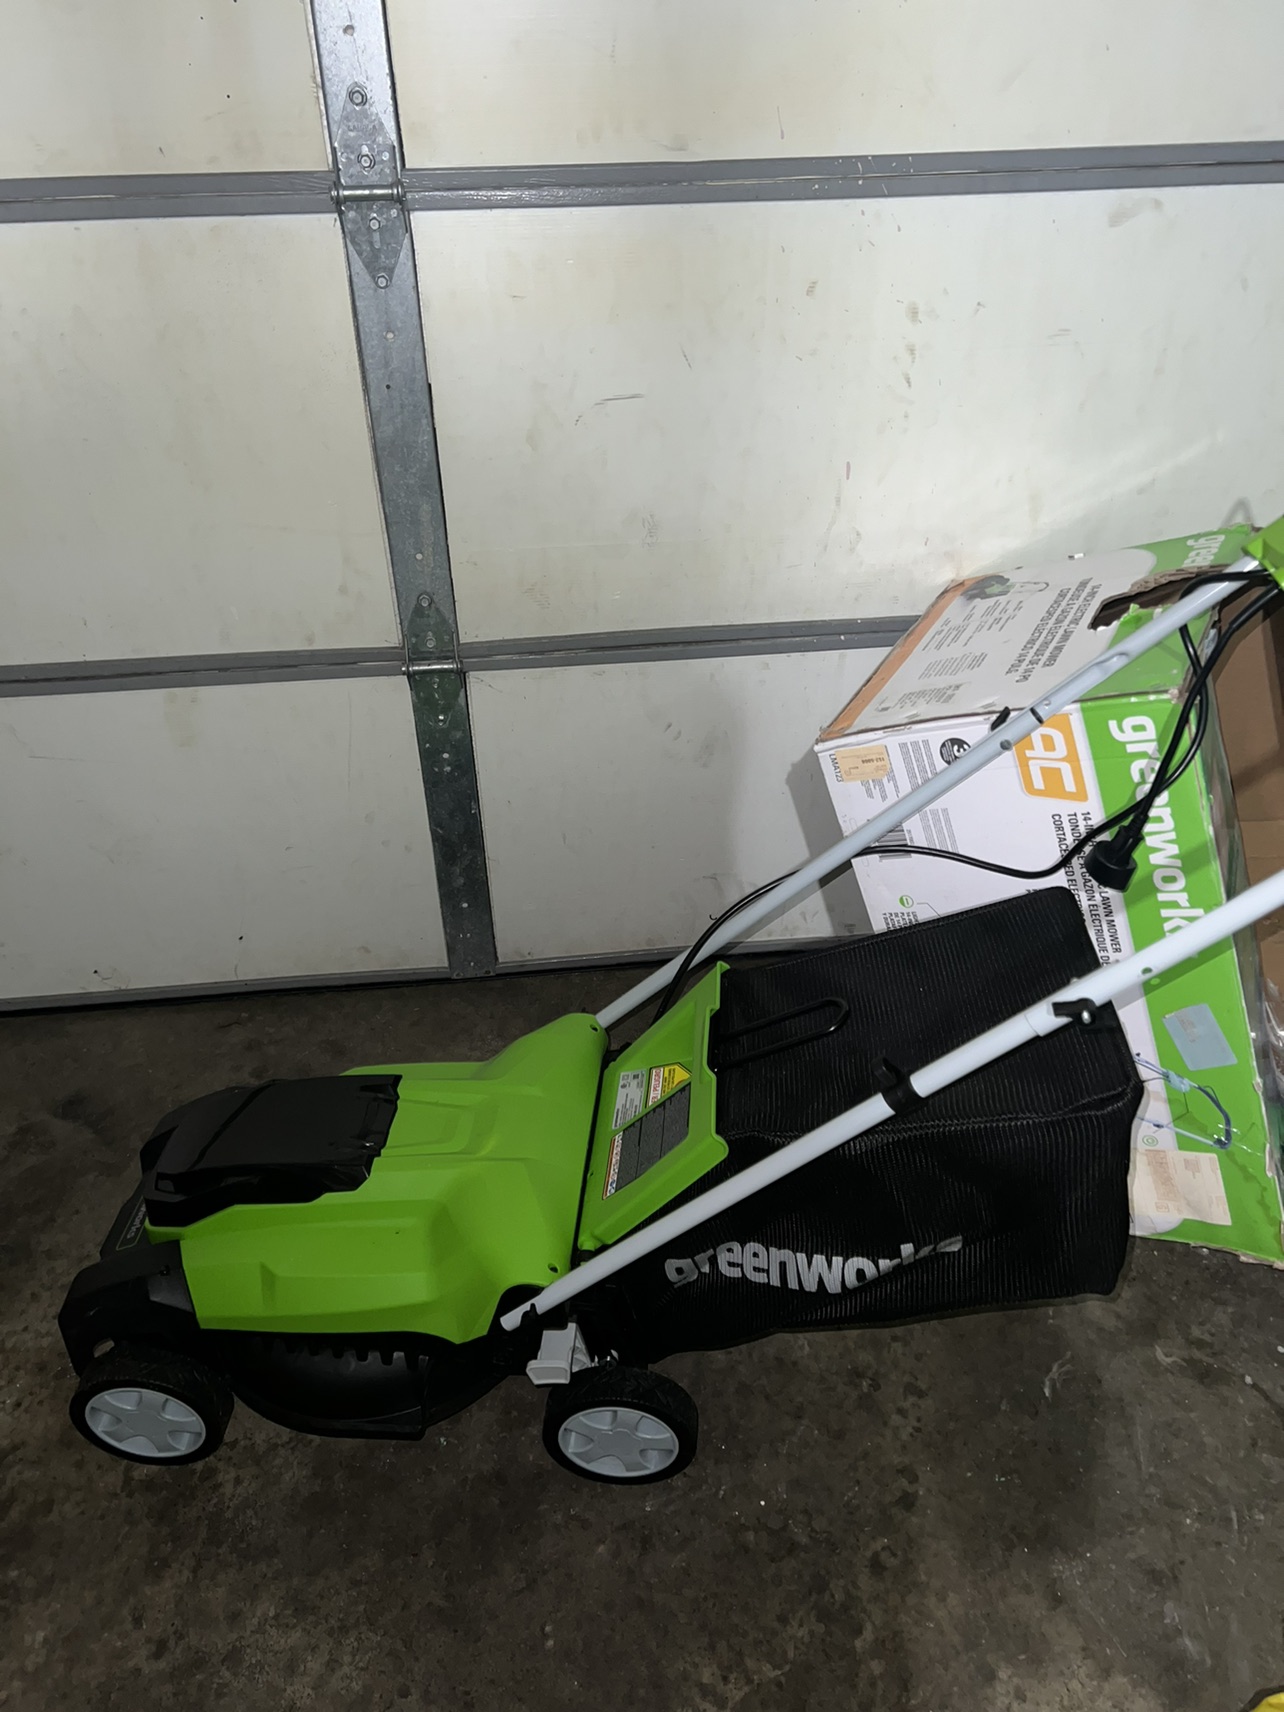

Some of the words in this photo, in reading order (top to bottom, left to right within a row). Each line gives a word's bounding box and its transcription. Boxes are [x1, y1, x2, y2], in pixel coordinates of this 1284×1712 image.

[1041, 644, 1066, 668] MOWER
[829, 753, 843, 783] LMA123
[1025, 727, 1077, 793] AC
[1067, 812, 1086, 861] TONDESE
[1080, 869, 1096, 902] GAZON
[1100, 887, 1114, 918] LAWN
[1105, 918, 1122, 953] MOWER
